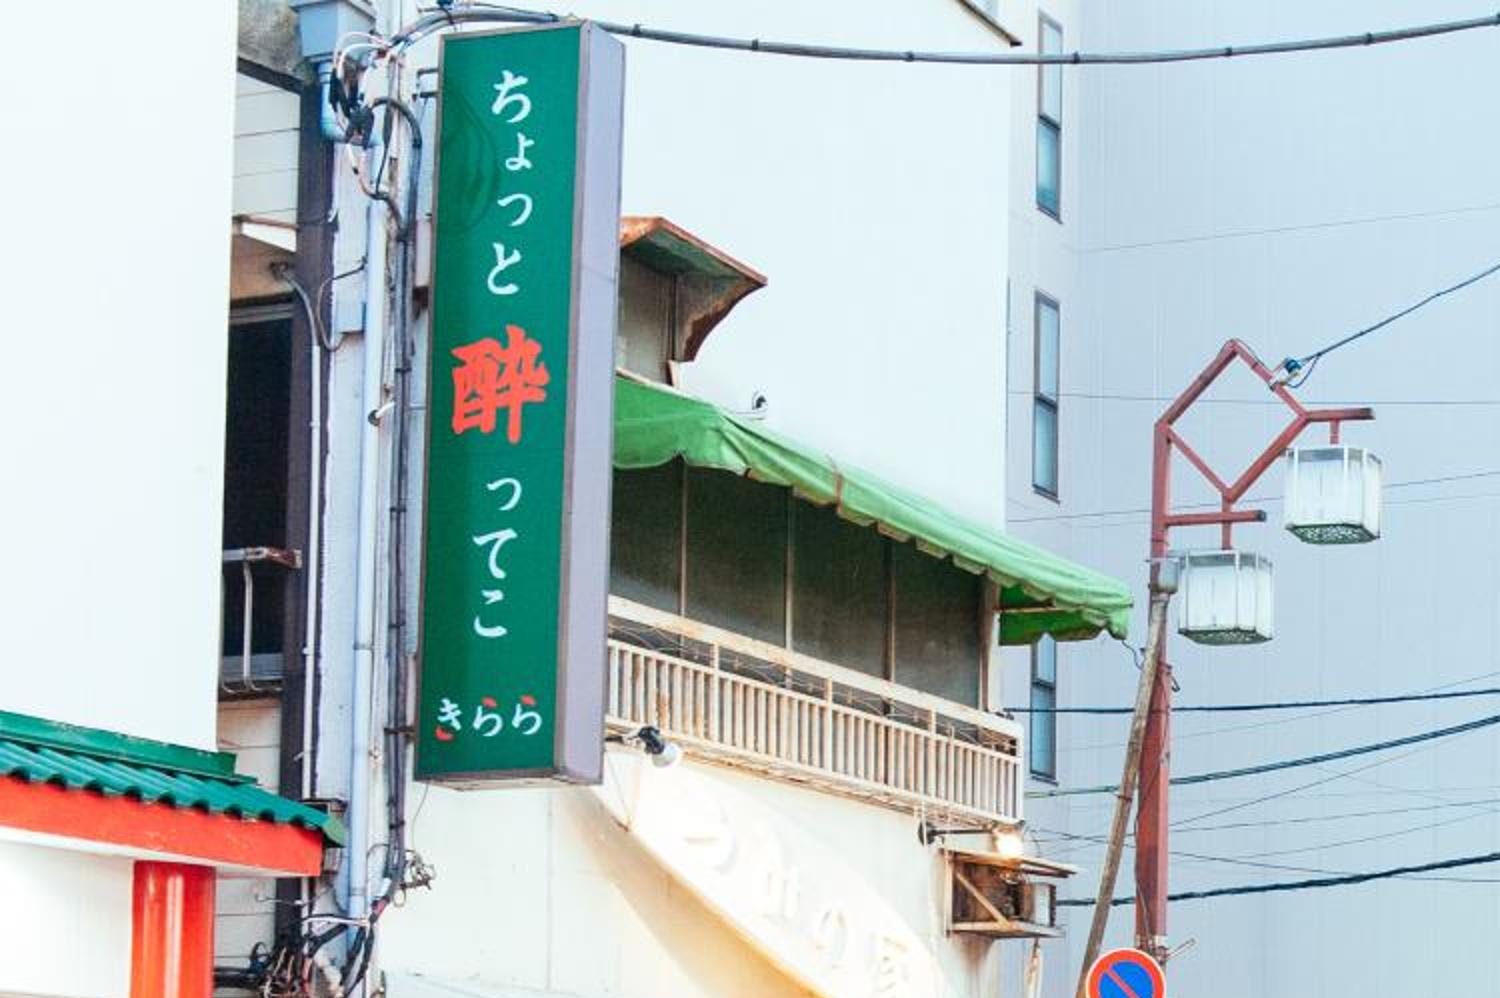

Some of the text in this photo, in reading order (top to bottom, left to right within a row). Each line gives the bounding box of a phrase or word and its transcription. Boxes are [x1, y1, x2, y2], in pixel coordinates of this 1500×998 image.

[450, 69, 551, 640] ちょっと酔ってこ
[434, 694, 542, 742] きらら
